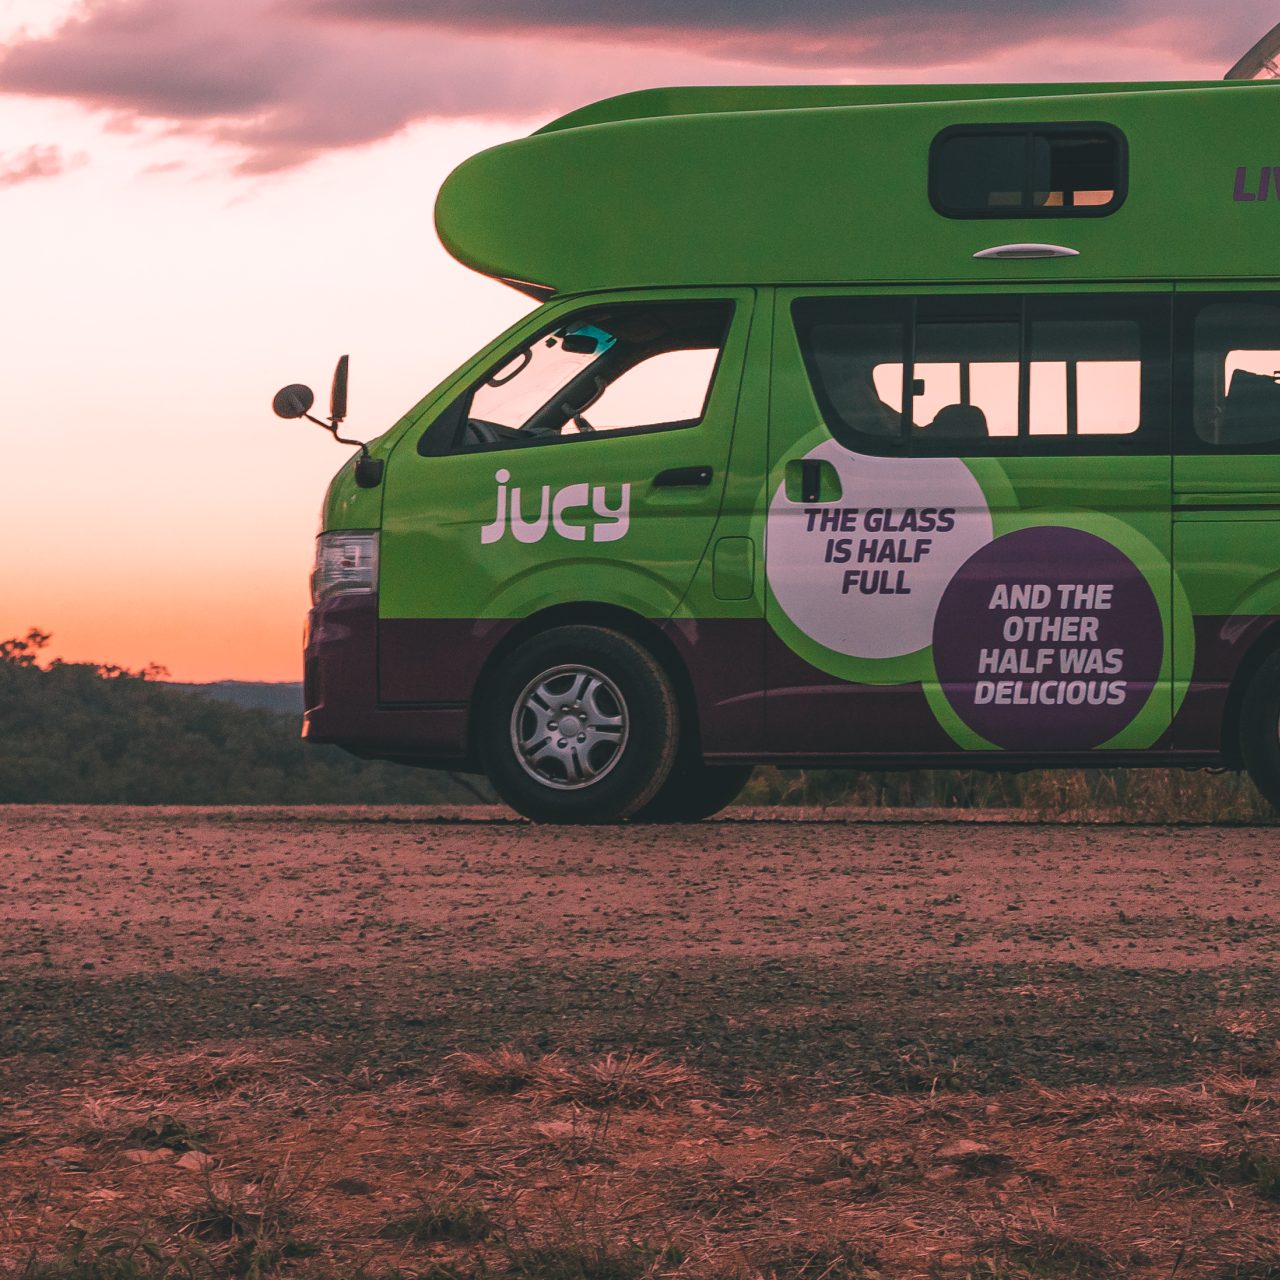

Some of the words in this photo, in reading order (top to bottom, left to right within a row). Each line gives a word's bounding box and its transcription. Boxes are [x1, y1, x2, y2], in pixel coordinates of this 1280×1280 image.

[481, 468, 631, 544] jucy
[804, 507, 859, 532] THE
[863, 507, 956, 532] GLASS
[824, 538, 852, 563] IS
[857, 538, 932, 563] HALF
[841, 569, 912, 595] FULL
[988, 584, 1052, 610] AND
[1057, 584, 1114, 610] THE
[1003, 616, 1099, 642] OTHER
[978, 648, 1054, 674] HALF
[1060, 648, 1124, 674] WAS
[974, 680, 1127, 705] DELICIOUS
